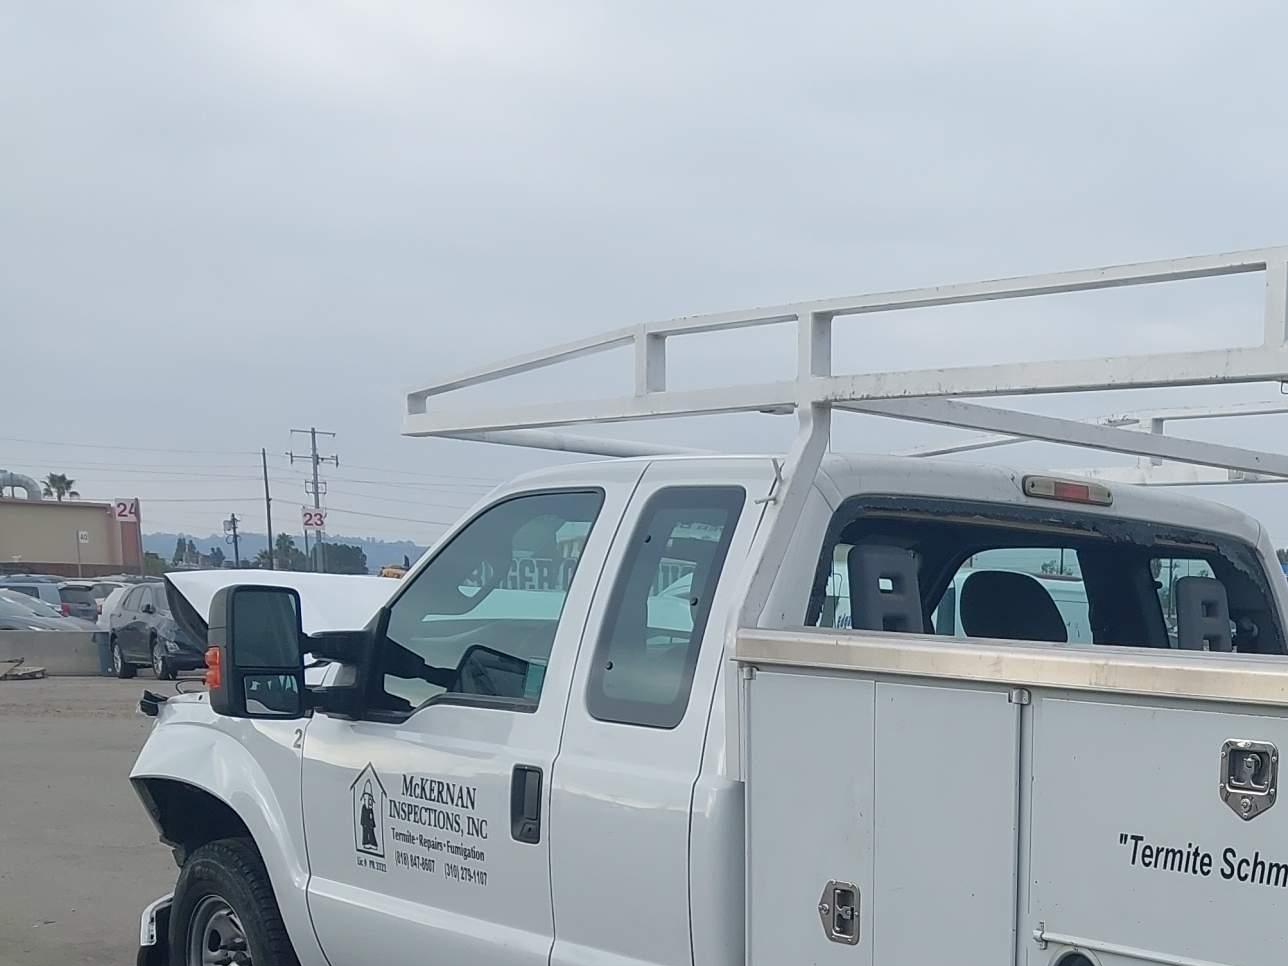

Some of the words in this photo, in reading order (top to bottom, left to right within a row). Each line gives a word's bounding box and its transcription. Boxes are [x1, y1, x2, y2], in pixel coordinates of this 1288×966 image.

[117, 502, 138, 518] 24
[303, 512, 324, 527] 23
[293, 728, 303, 749] 2
[401, 773, 476, 810] McKERNAN
[389, 799, 463, 837] INSPECTIONS,
[467, 815, 488, 839] INC
[1118, 832, 1213, 877] "Termite
